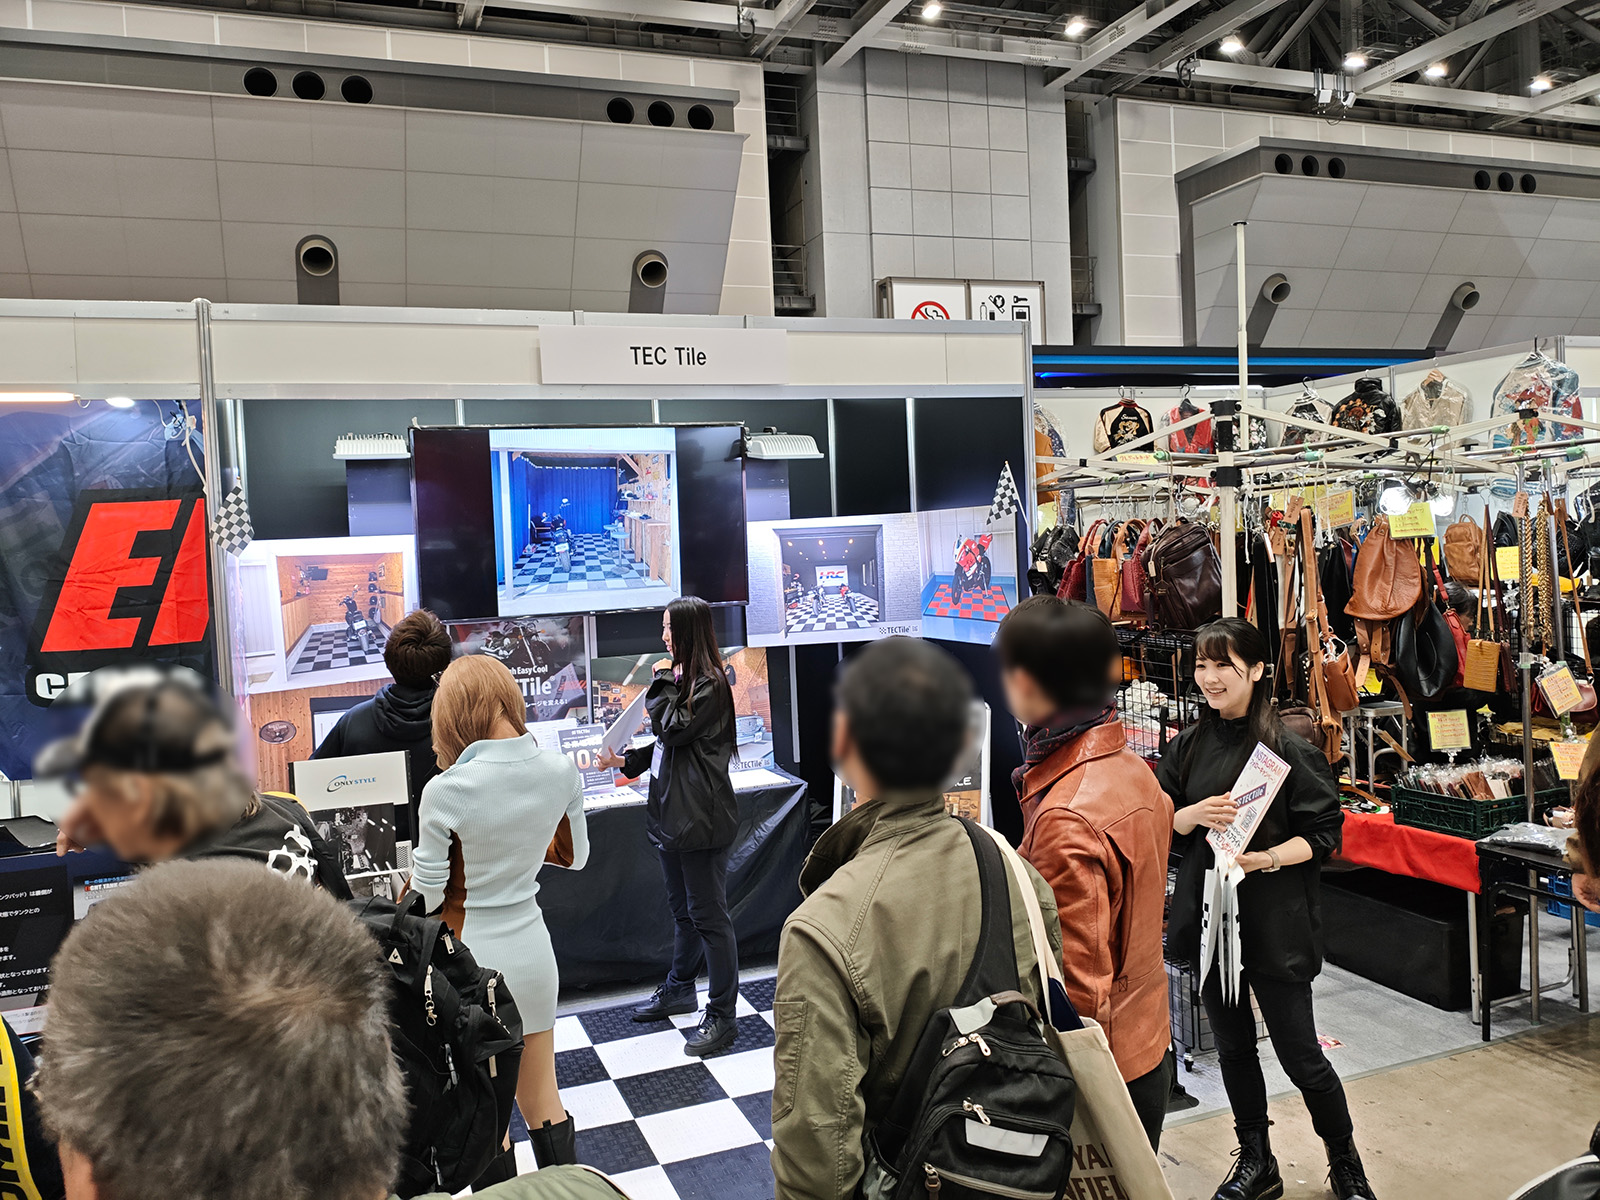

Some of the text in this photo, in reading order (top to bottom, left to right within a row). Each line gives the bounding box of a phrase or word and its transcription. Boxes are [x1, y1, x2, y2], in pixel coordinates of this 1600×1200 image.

[630, 346, 707, 366] TEC Tile
[517, 666, 533, 676] Easy
[533, 664, 548, 673] Cool
[1253, 748, 1284, 777] INSTAGRAM
